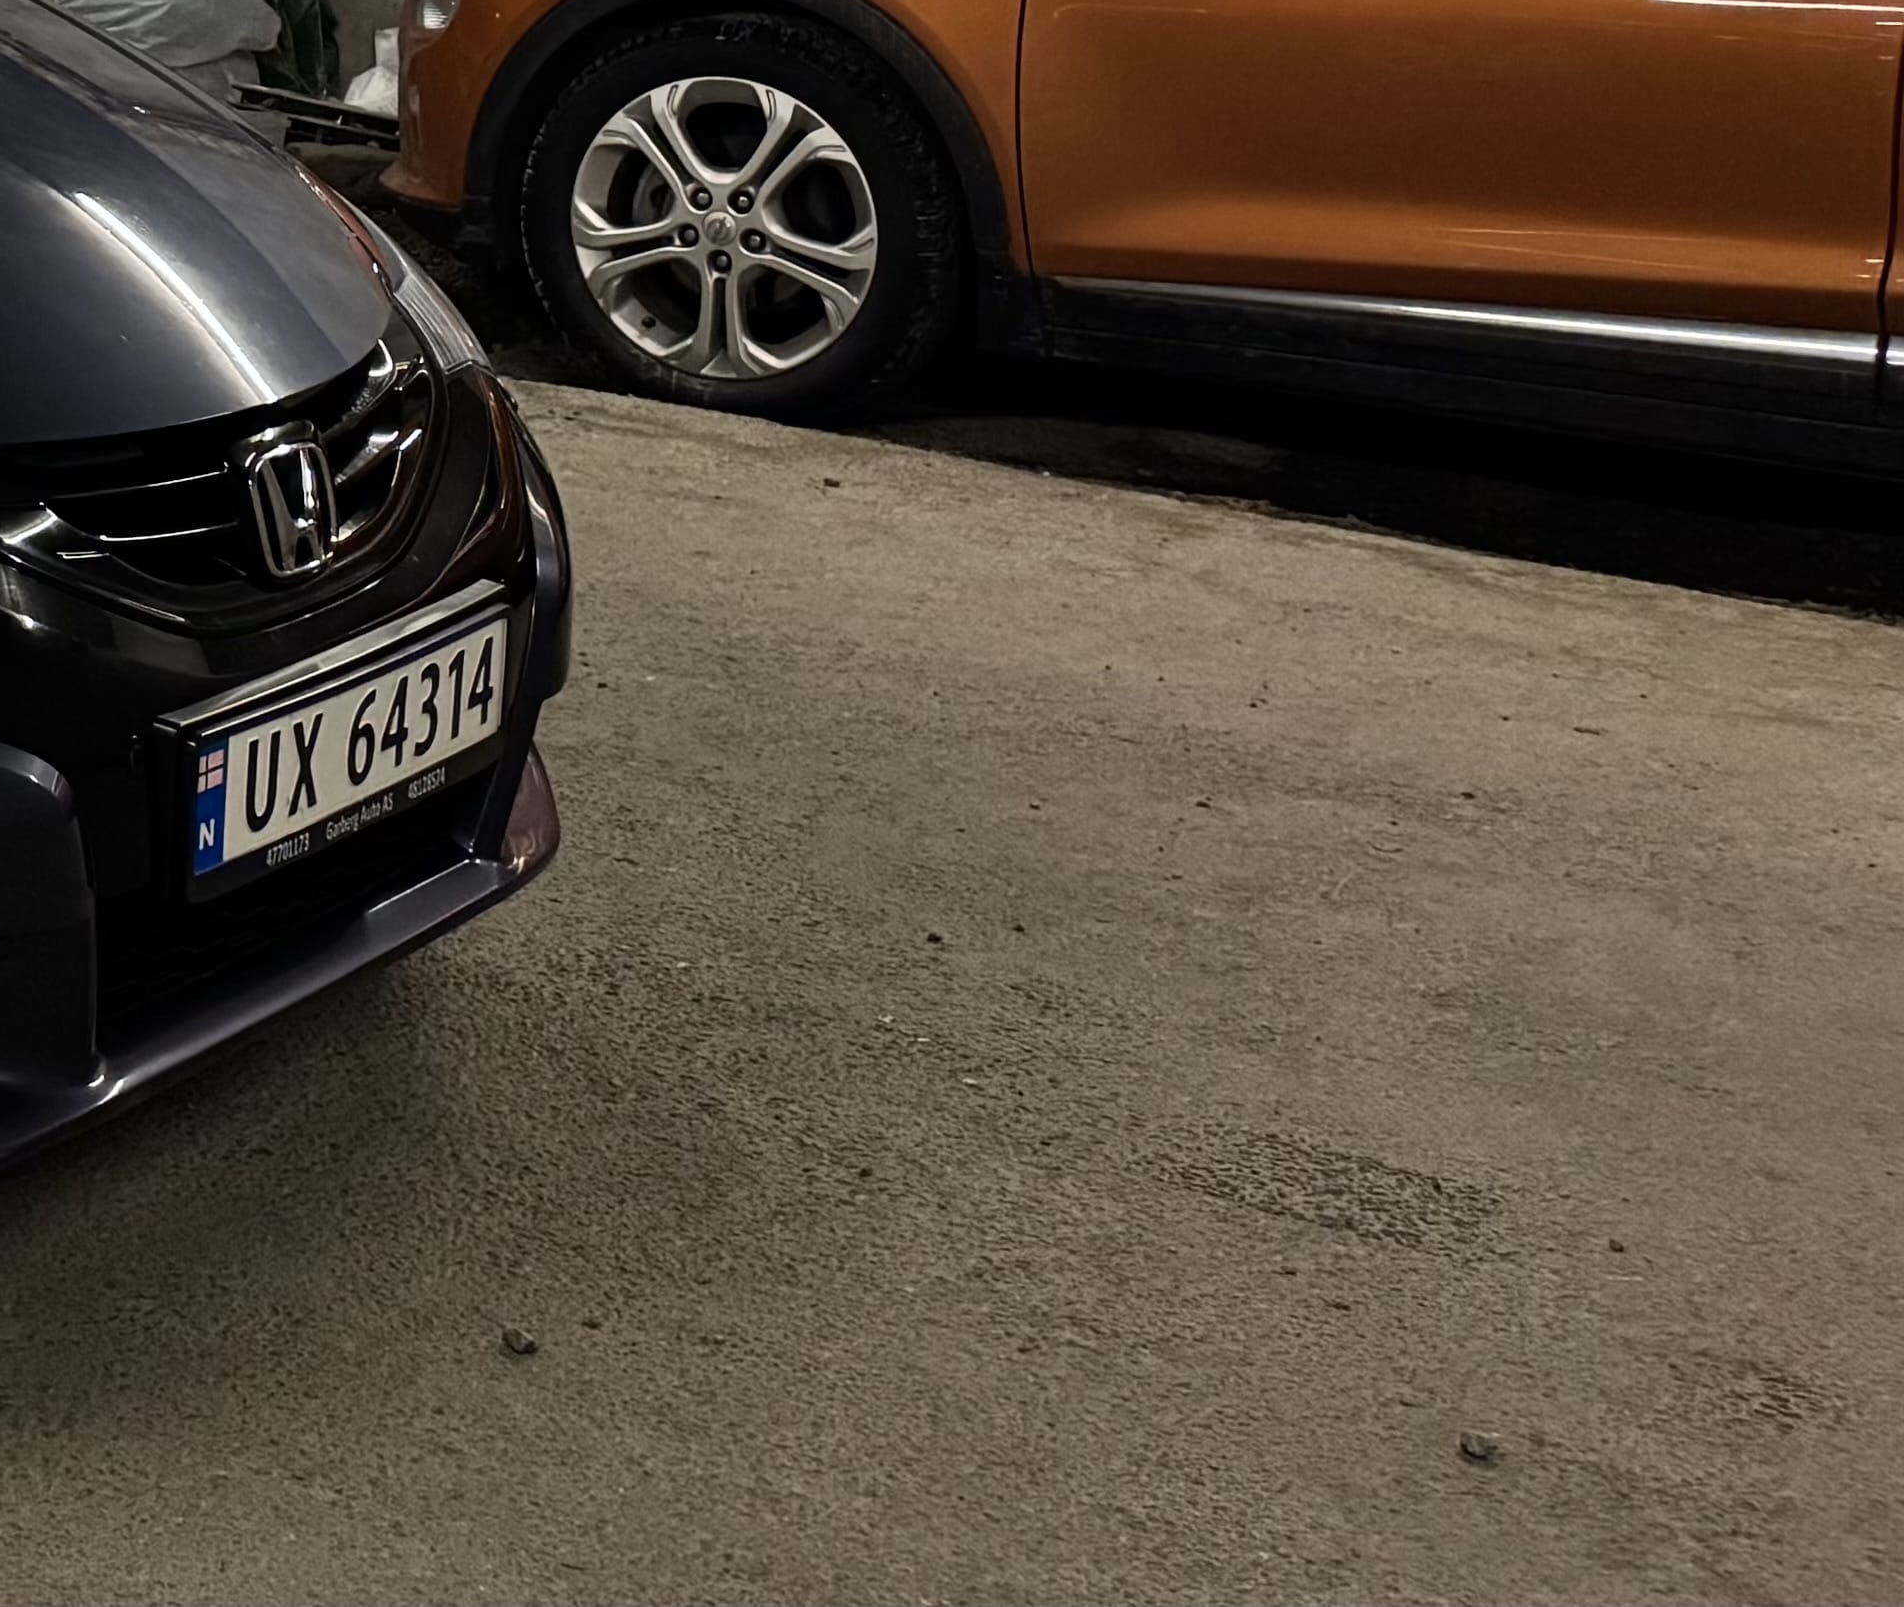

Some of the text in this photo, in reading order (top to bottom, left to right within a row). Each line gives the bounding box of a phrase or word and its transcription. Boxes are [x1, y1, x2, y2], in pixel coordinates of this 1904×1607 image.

[245, 636, 494, 832] UX 64314
[360, 803, 381, 825] Auto
[382, 792, 394, 812] AS
[199, 819, 215, 851] N
